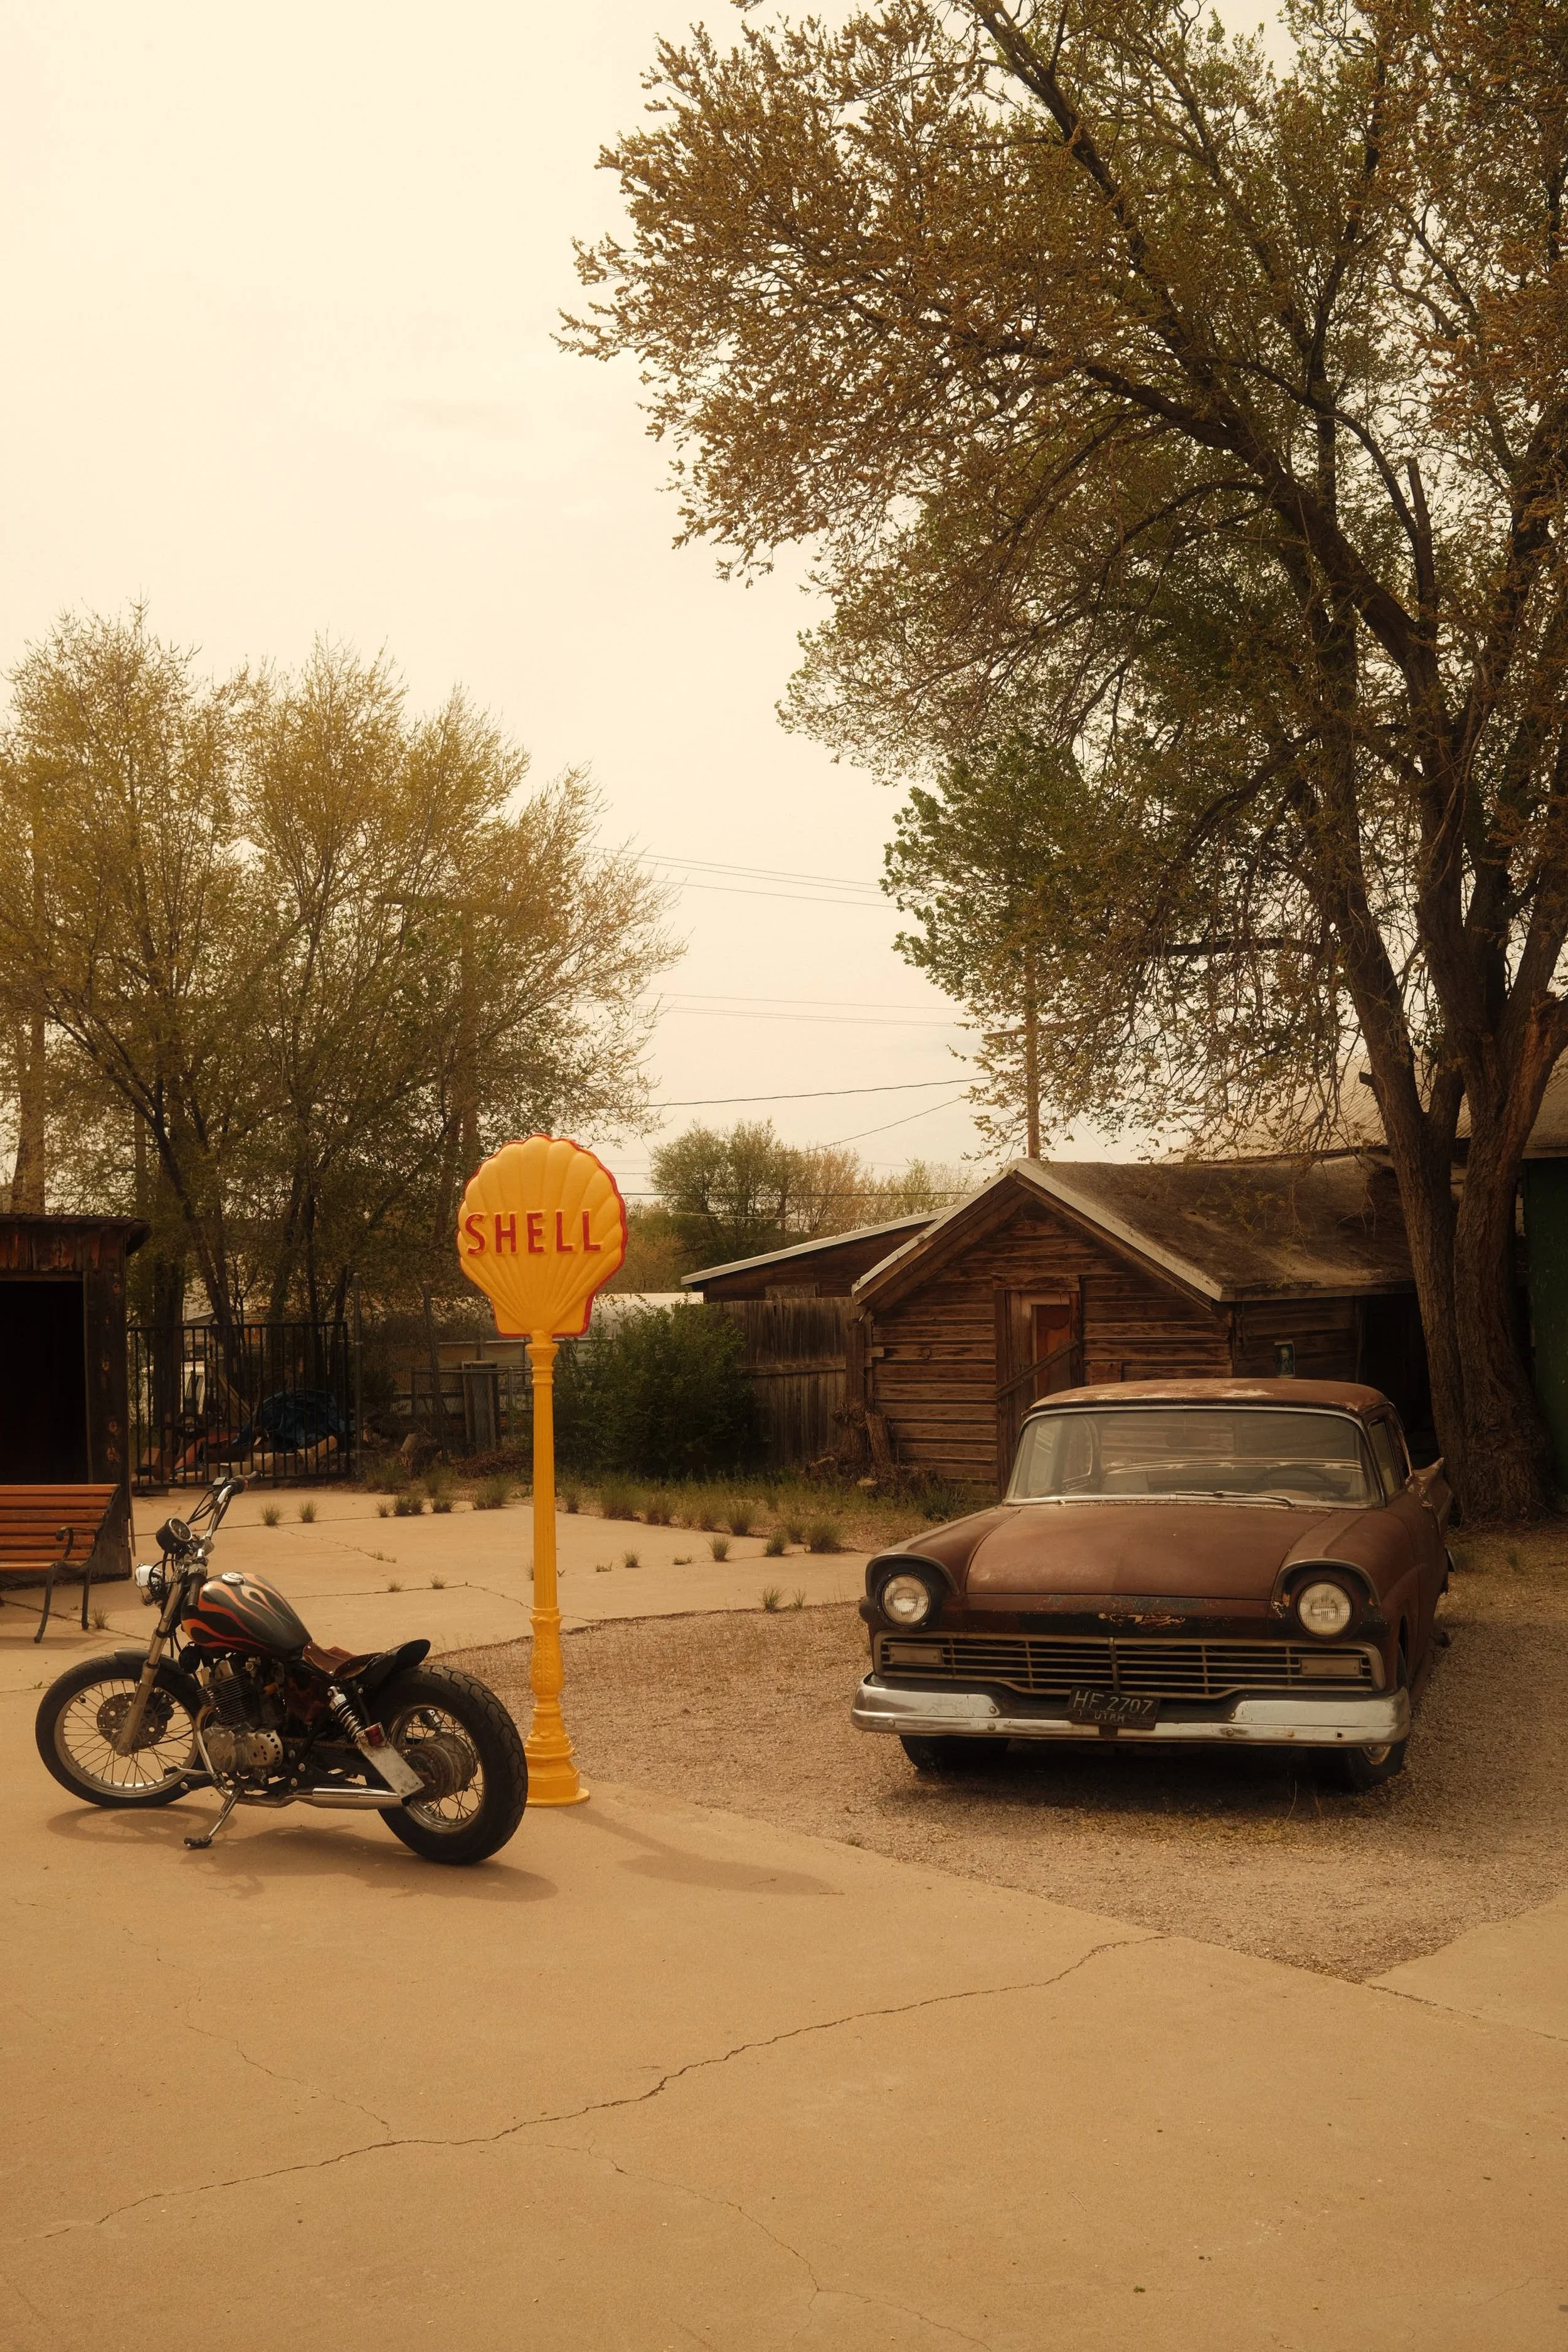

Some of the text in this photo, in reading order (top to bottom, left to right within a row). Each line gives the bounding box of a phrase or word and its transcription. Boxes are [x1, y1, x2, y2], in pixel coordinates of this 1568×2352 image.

[465, 1210, 601, 1254] SHELL
[1073, 1690, 1154, 1715] HF 2707
[1094, 1710, 1125, 1723] UTAH
